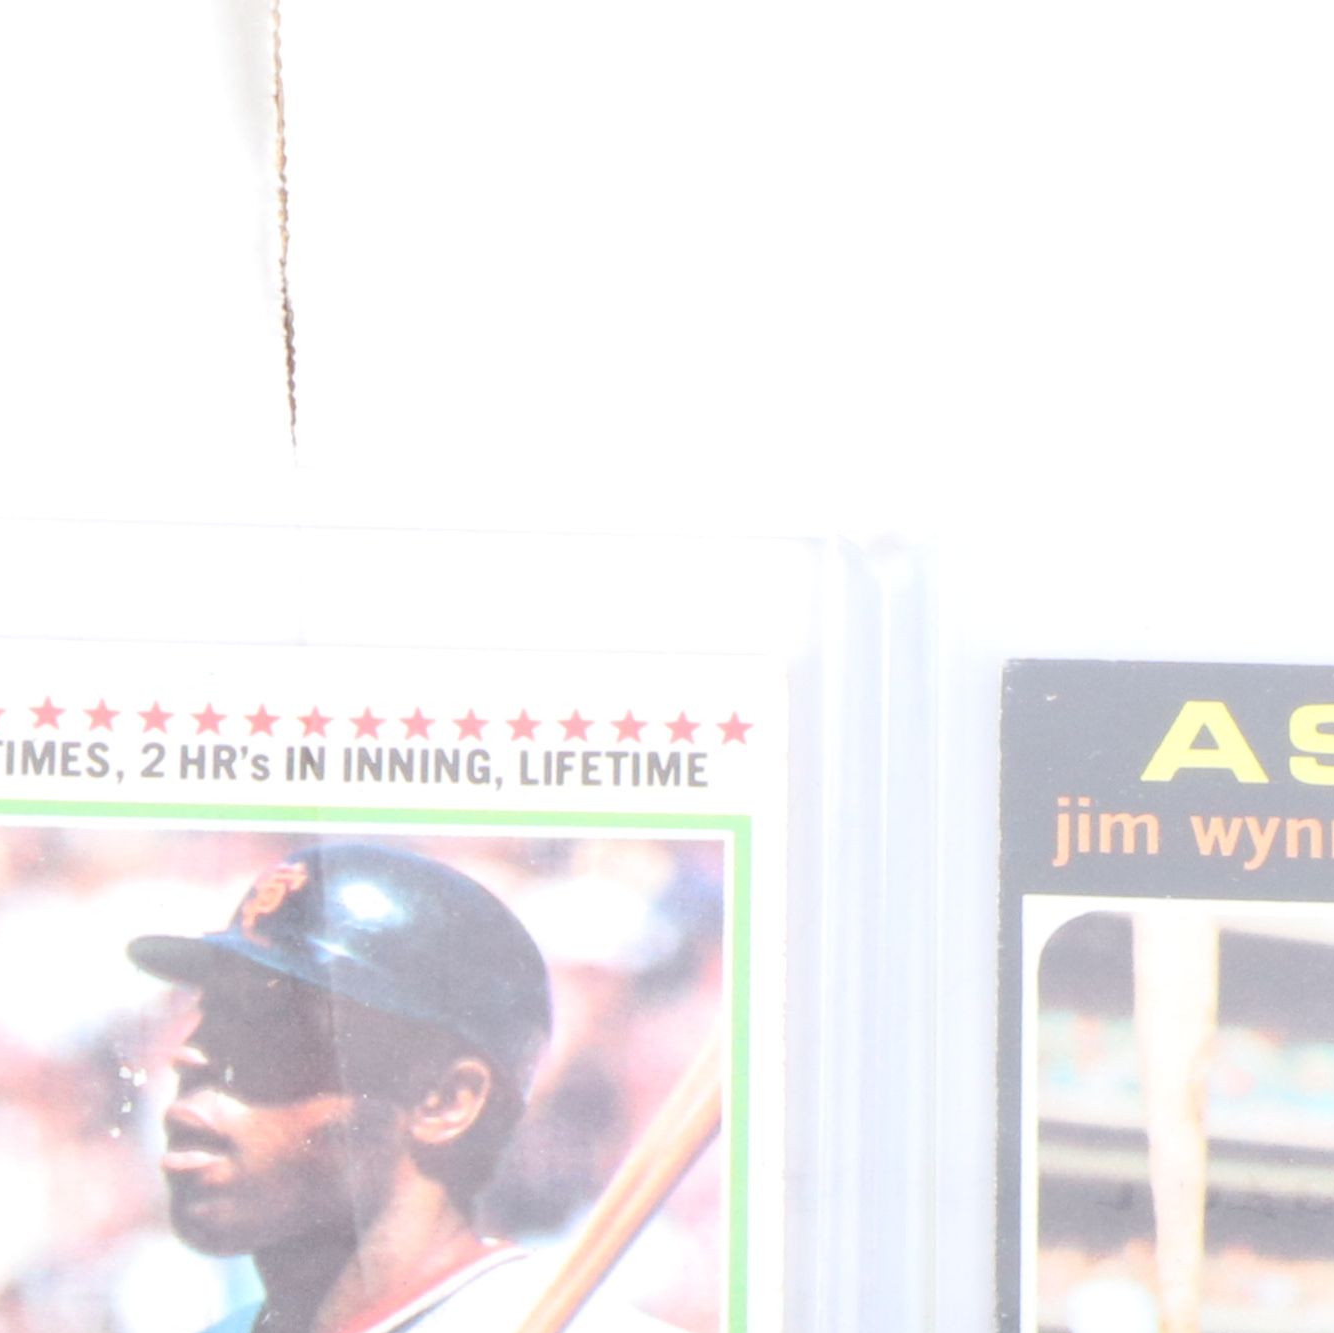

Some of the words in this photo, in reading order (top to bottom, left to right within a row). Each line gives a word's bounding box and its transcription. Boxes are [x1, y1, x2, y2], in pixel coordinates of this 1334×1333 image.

[141, 742, 165, 778] 2
[180, 744, 270, 782] HR's
[286, 746, 325, 781] IN
[343, 747, 502, 790] INNING,
[520, 750, 708, 788] LIFETIME
[1052, 796, 1160, 867] jim
